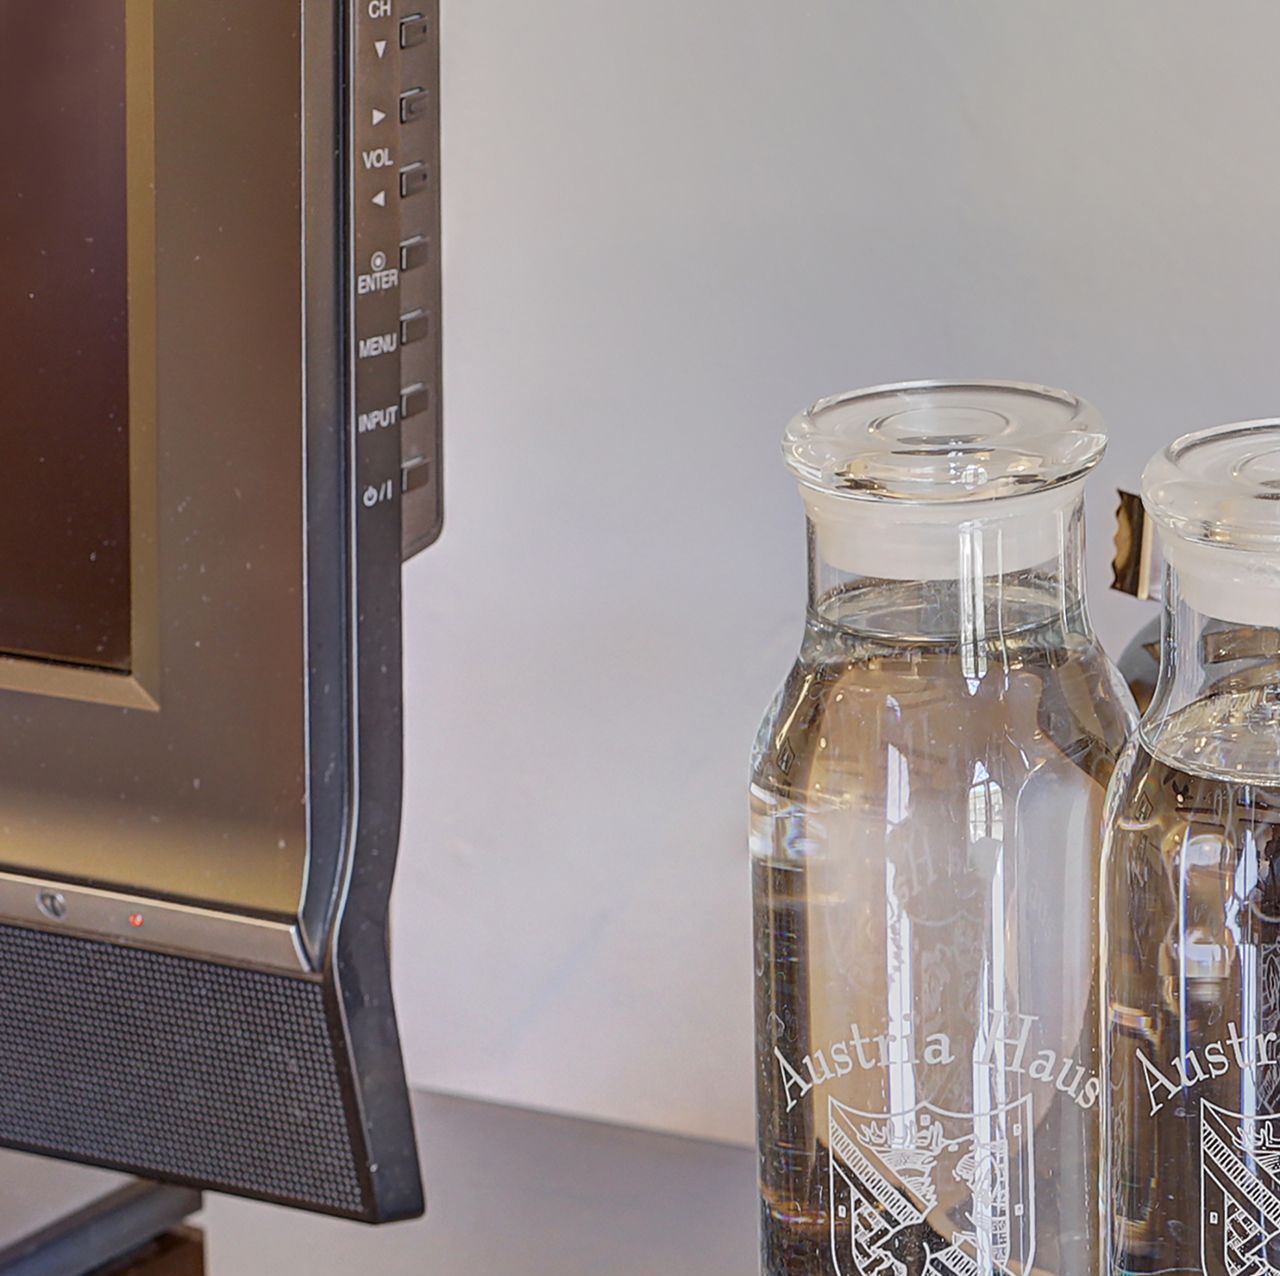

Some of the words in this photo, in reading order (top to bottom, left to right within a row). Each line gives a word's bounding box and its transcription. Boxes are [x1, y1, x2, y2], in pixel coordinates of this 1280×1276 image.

[368, 1, 392, 18] CH
[362, 148, 393, 169] VOL
[357, 268, 398, 295] ENTER
[359, 333, 397, 359] MENU
[358, 405, 398, 433] INPUT
[773, 1013, 956, 1112] Austria
[974, 1010, 1100, 1110] Haus
